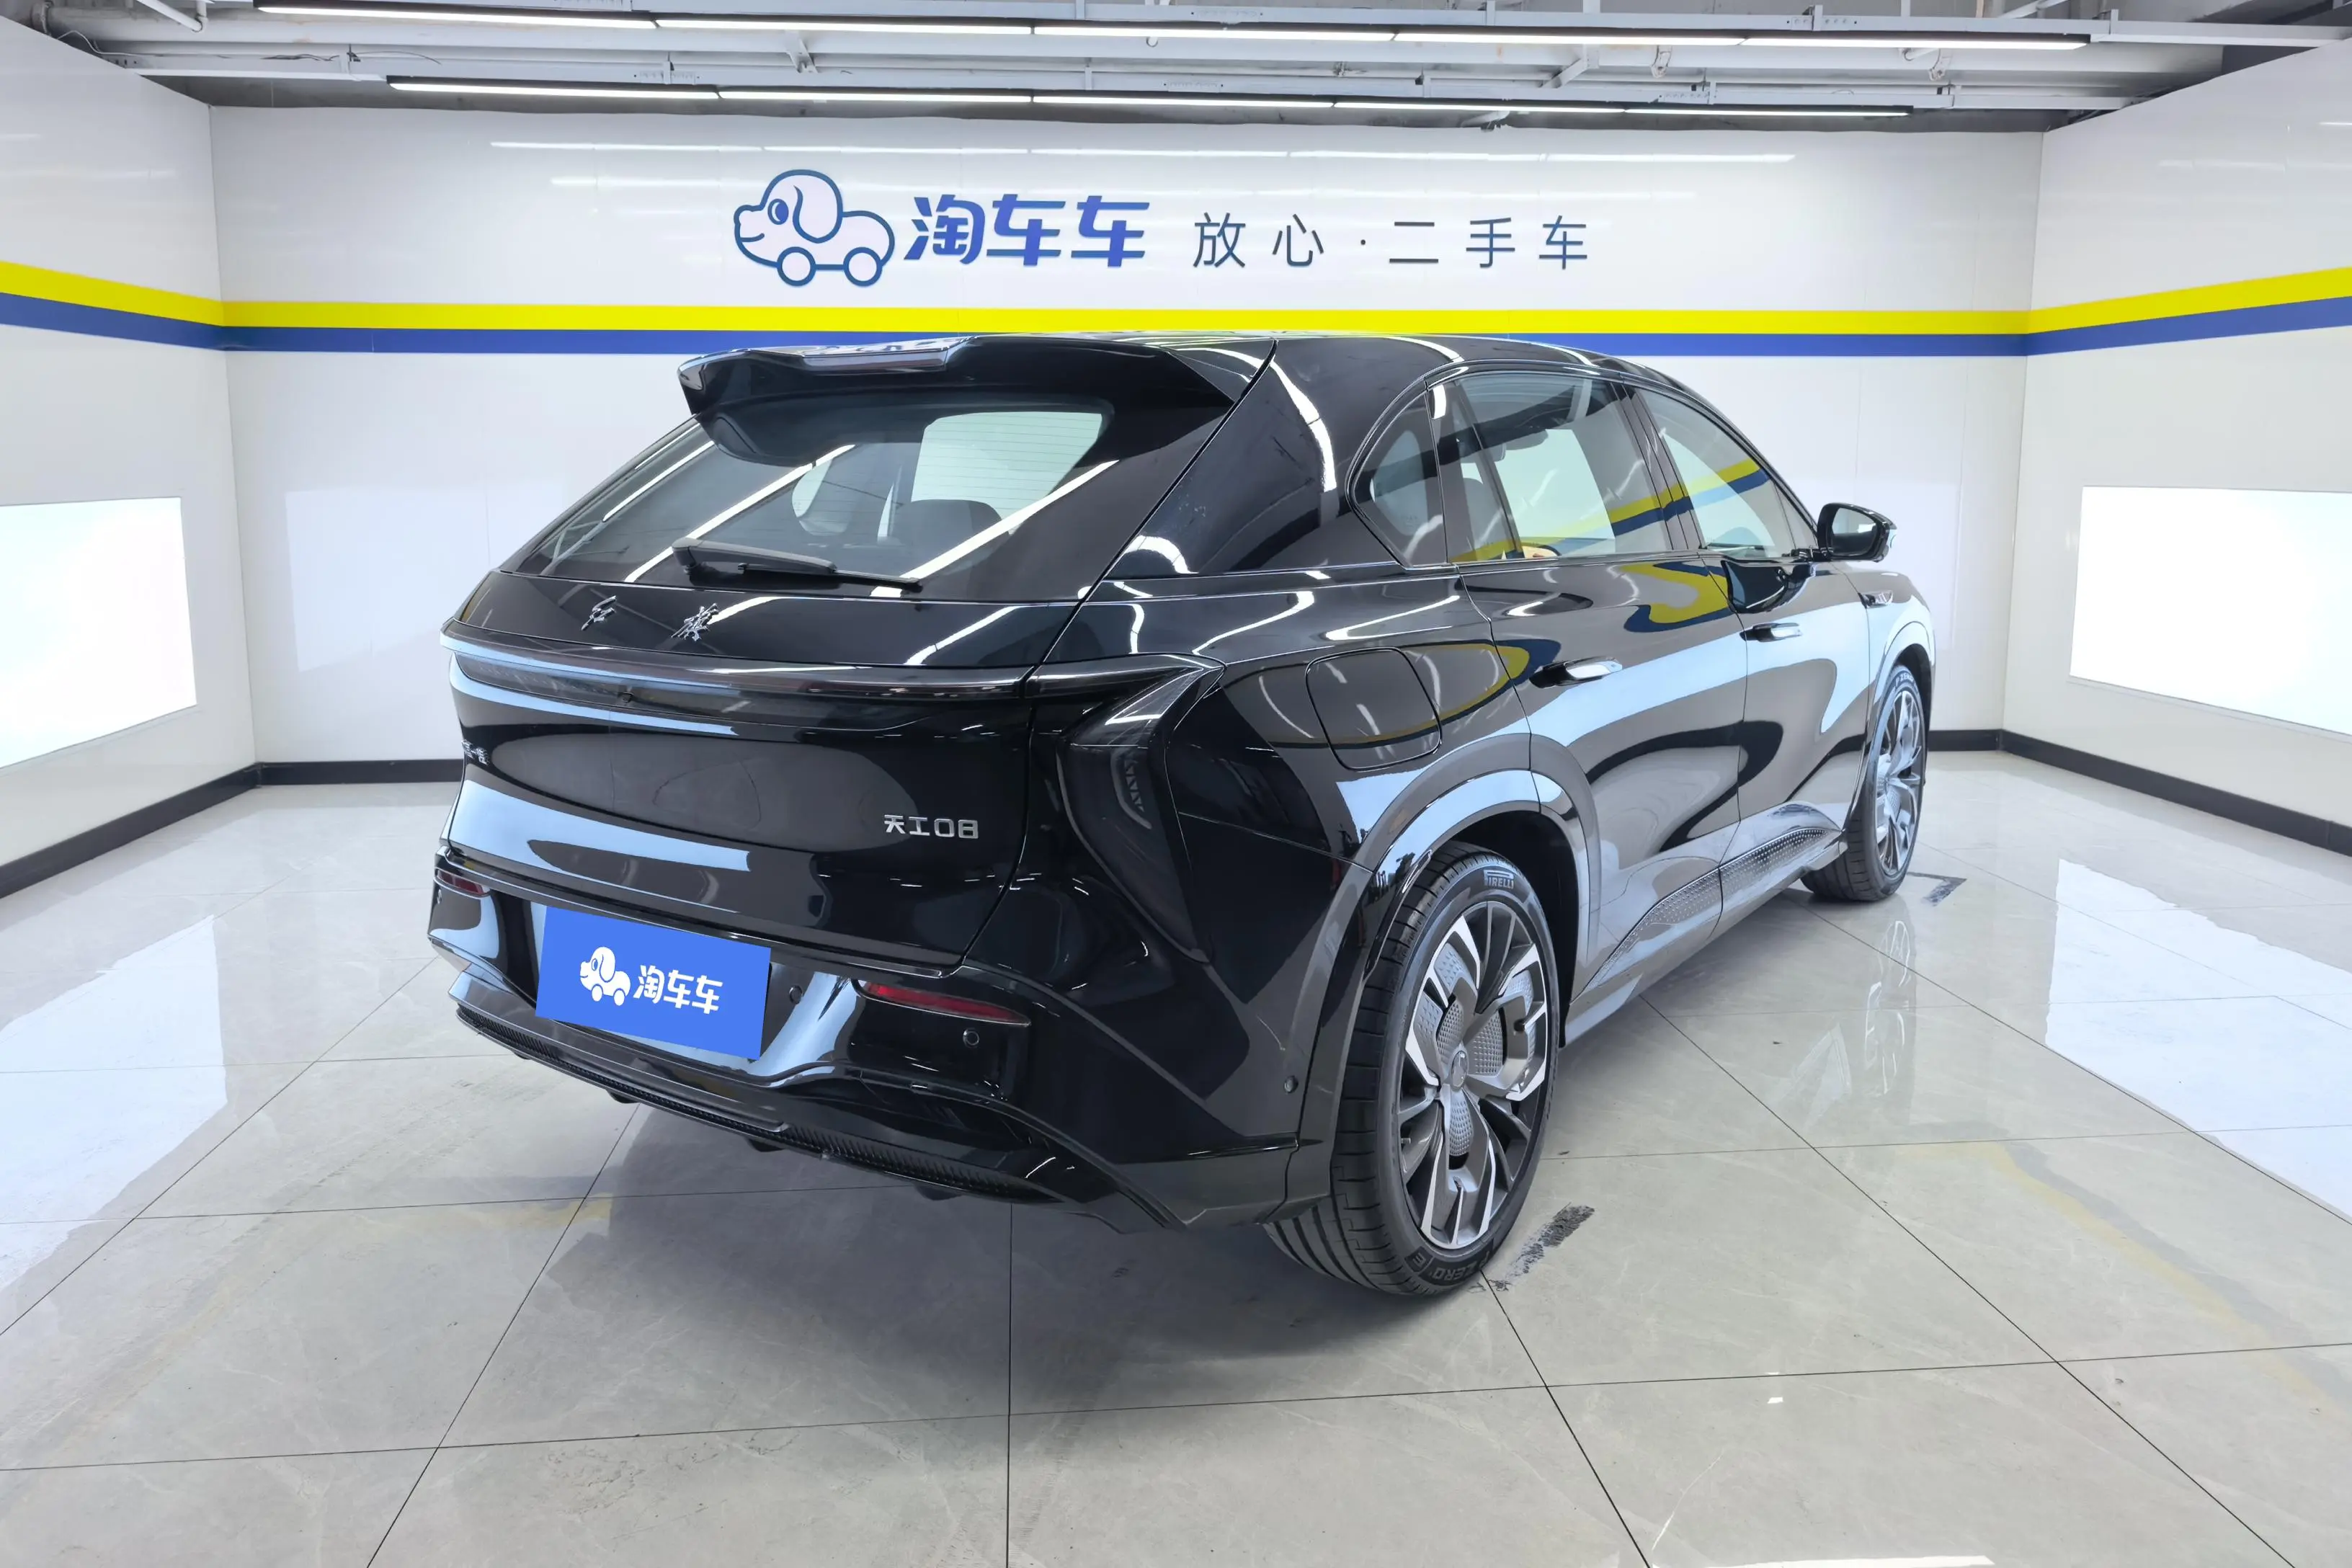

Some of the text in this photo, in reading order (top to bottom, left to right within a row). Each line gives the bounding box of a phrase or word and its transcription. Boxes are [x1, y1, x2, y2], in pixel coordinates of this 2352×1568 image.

[904, 193, 1150, 269] 淘车车
[883, 814, 979, 839] 天工08
[1483, 869, 1514, 889] PIRELLI
